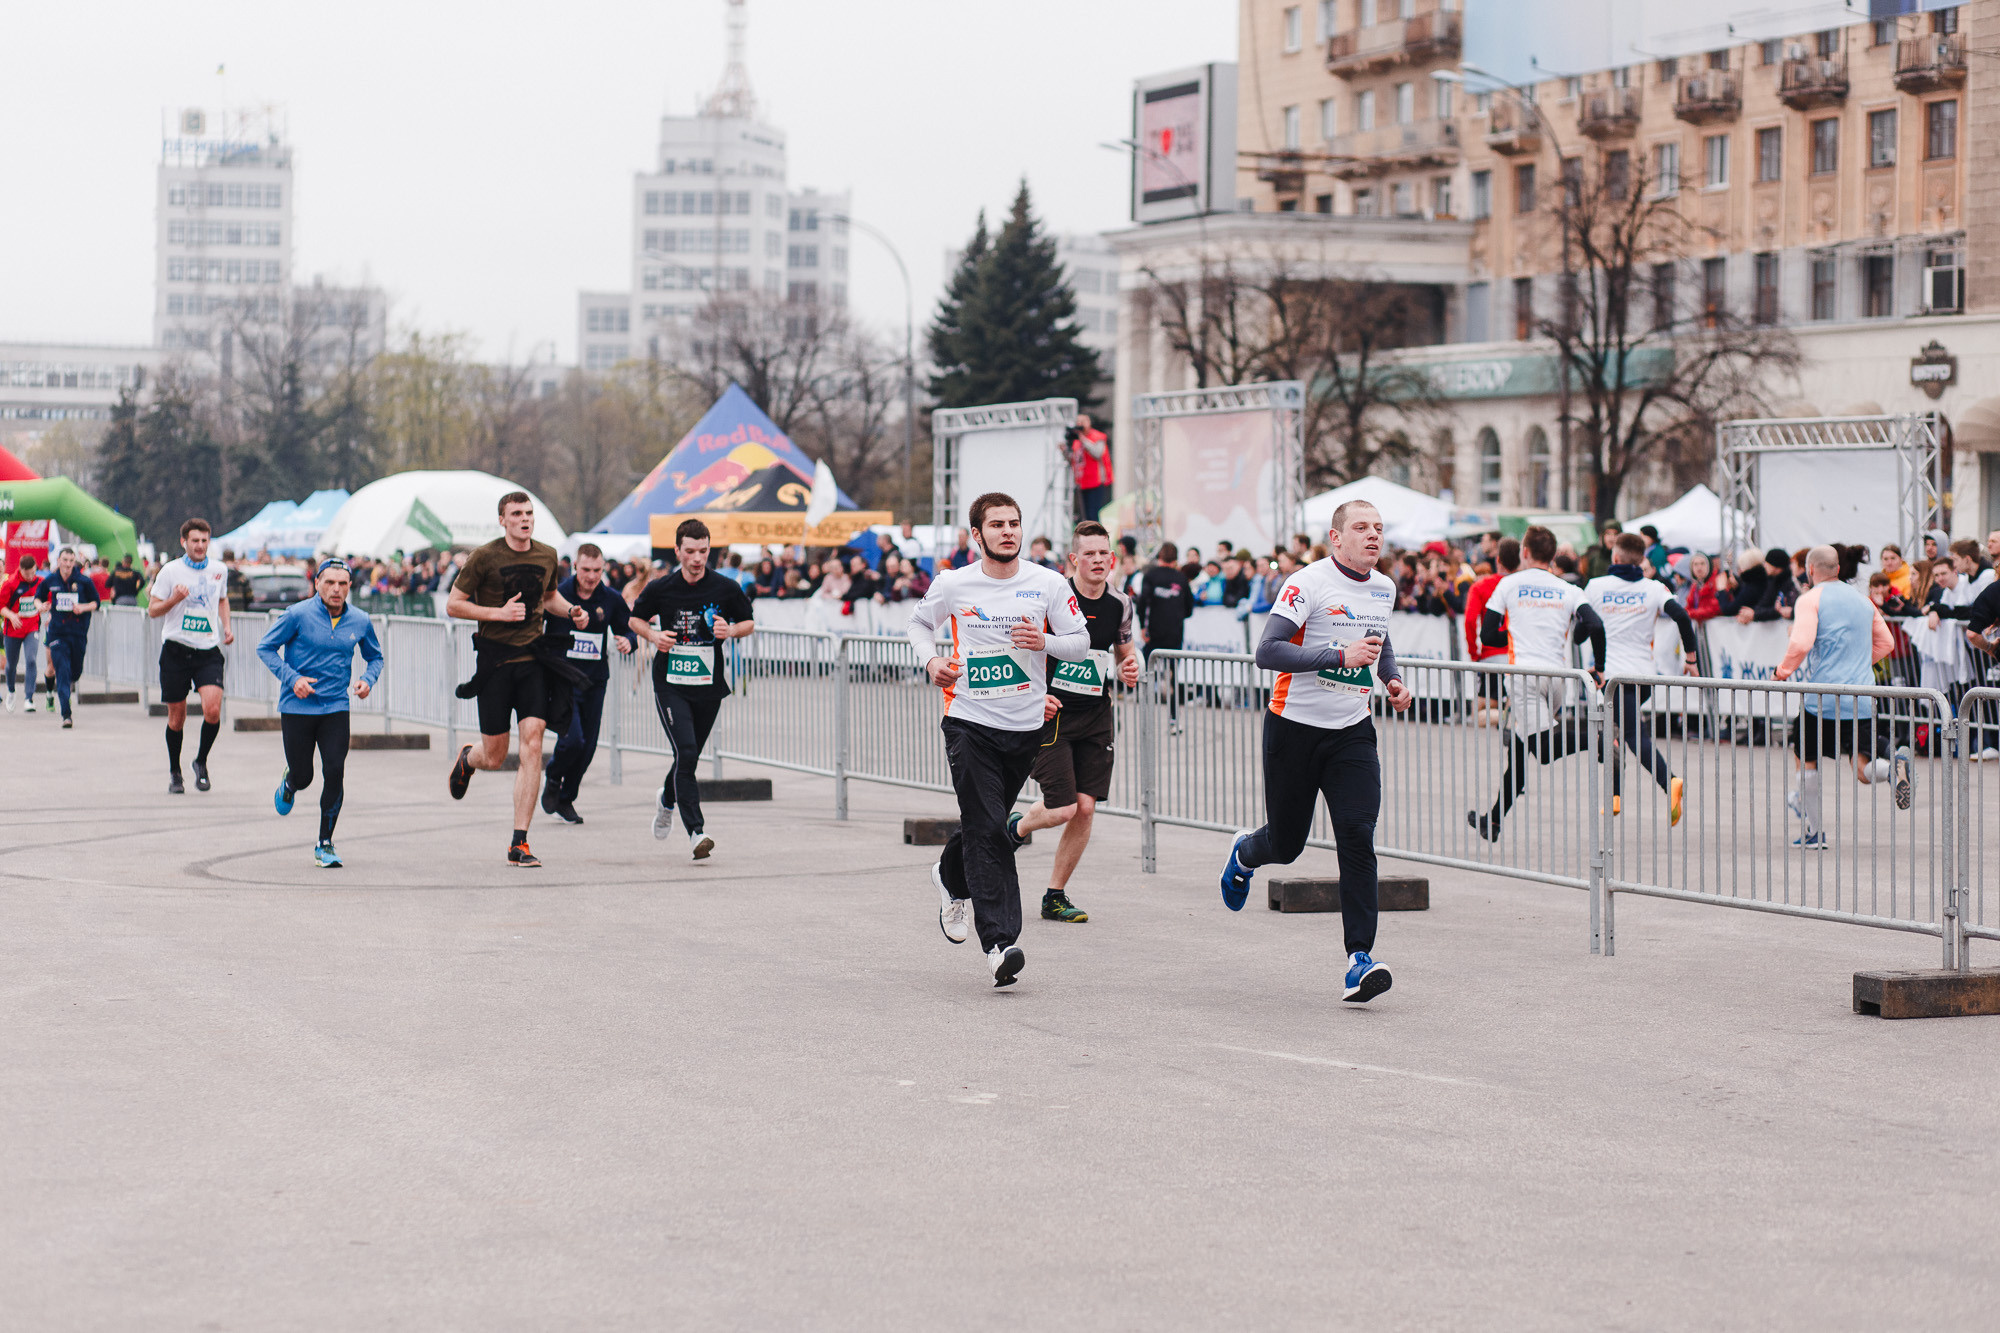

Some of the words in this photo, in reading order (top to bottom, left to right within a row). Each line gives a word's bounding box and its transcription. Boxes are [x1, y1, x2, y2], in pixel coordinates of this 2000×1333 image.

[697, 424, 747, 453] Red
[671, 660, 700, 673] 1382
[969, 664, 1014, 682] 2030
[1059, 662, 1092, 679] 2776
